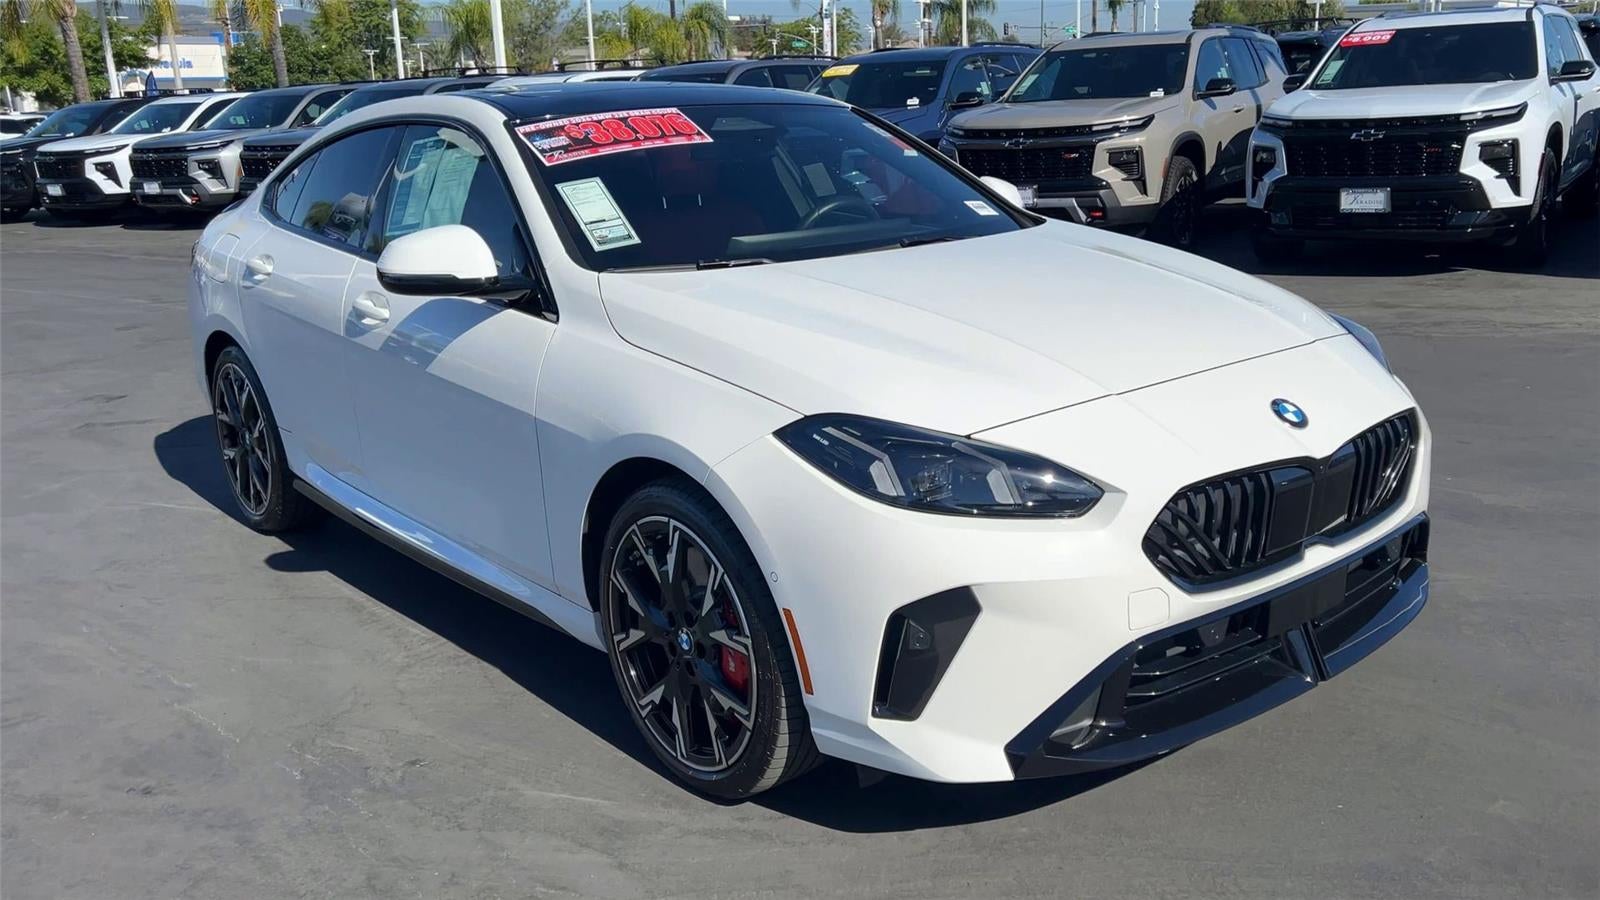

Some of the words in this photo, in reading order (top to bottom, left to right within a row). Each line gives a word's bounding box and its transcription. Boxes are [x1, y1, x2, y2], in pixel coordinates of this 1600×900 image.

[519, 119, 570, 133] PRE-OWNED
[591, 112, 612, 121] BMW
[564, 114, 698, 144] $38,076
